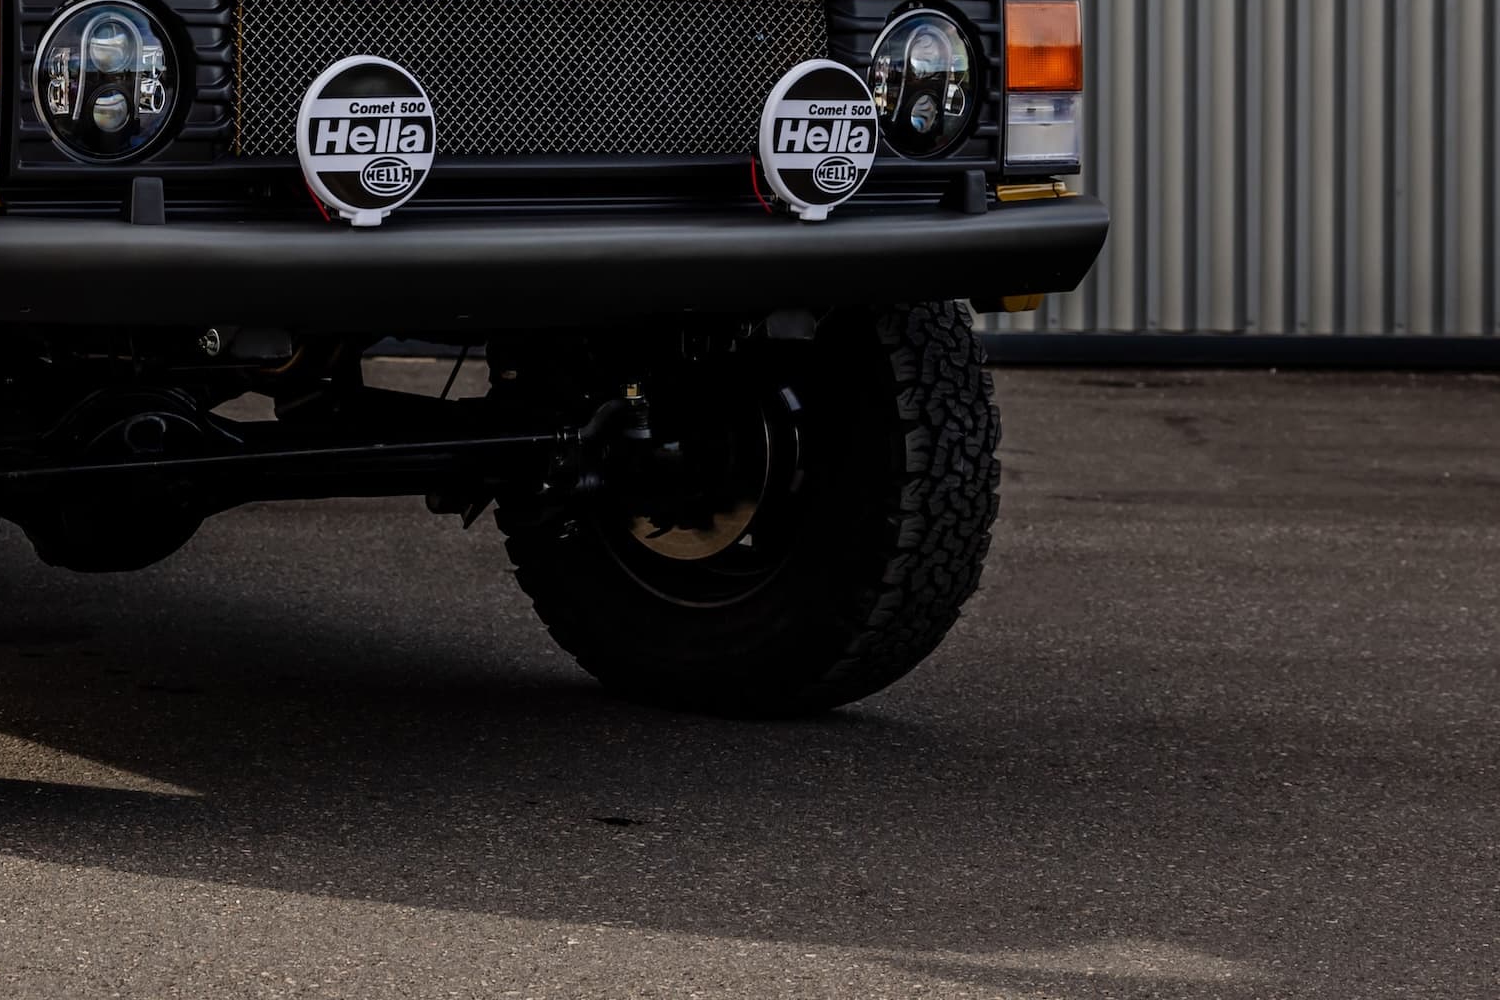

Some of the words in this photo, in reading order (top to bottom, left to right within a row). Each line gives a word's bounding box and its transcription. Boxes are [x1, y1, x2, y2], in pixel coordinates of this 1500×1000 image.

[349, 101, 396, 114] Comet
[400, 102, 426, 114] 500
[808, 103, 847, 116] Comet
[851, 105, 872, 116] 500
[314, 118, 426, 154] Hella
[777, 119, 871, 153] Hella
[366, 166, 412, 183] HELLA
[817, 165, 857, 182] HELLA
